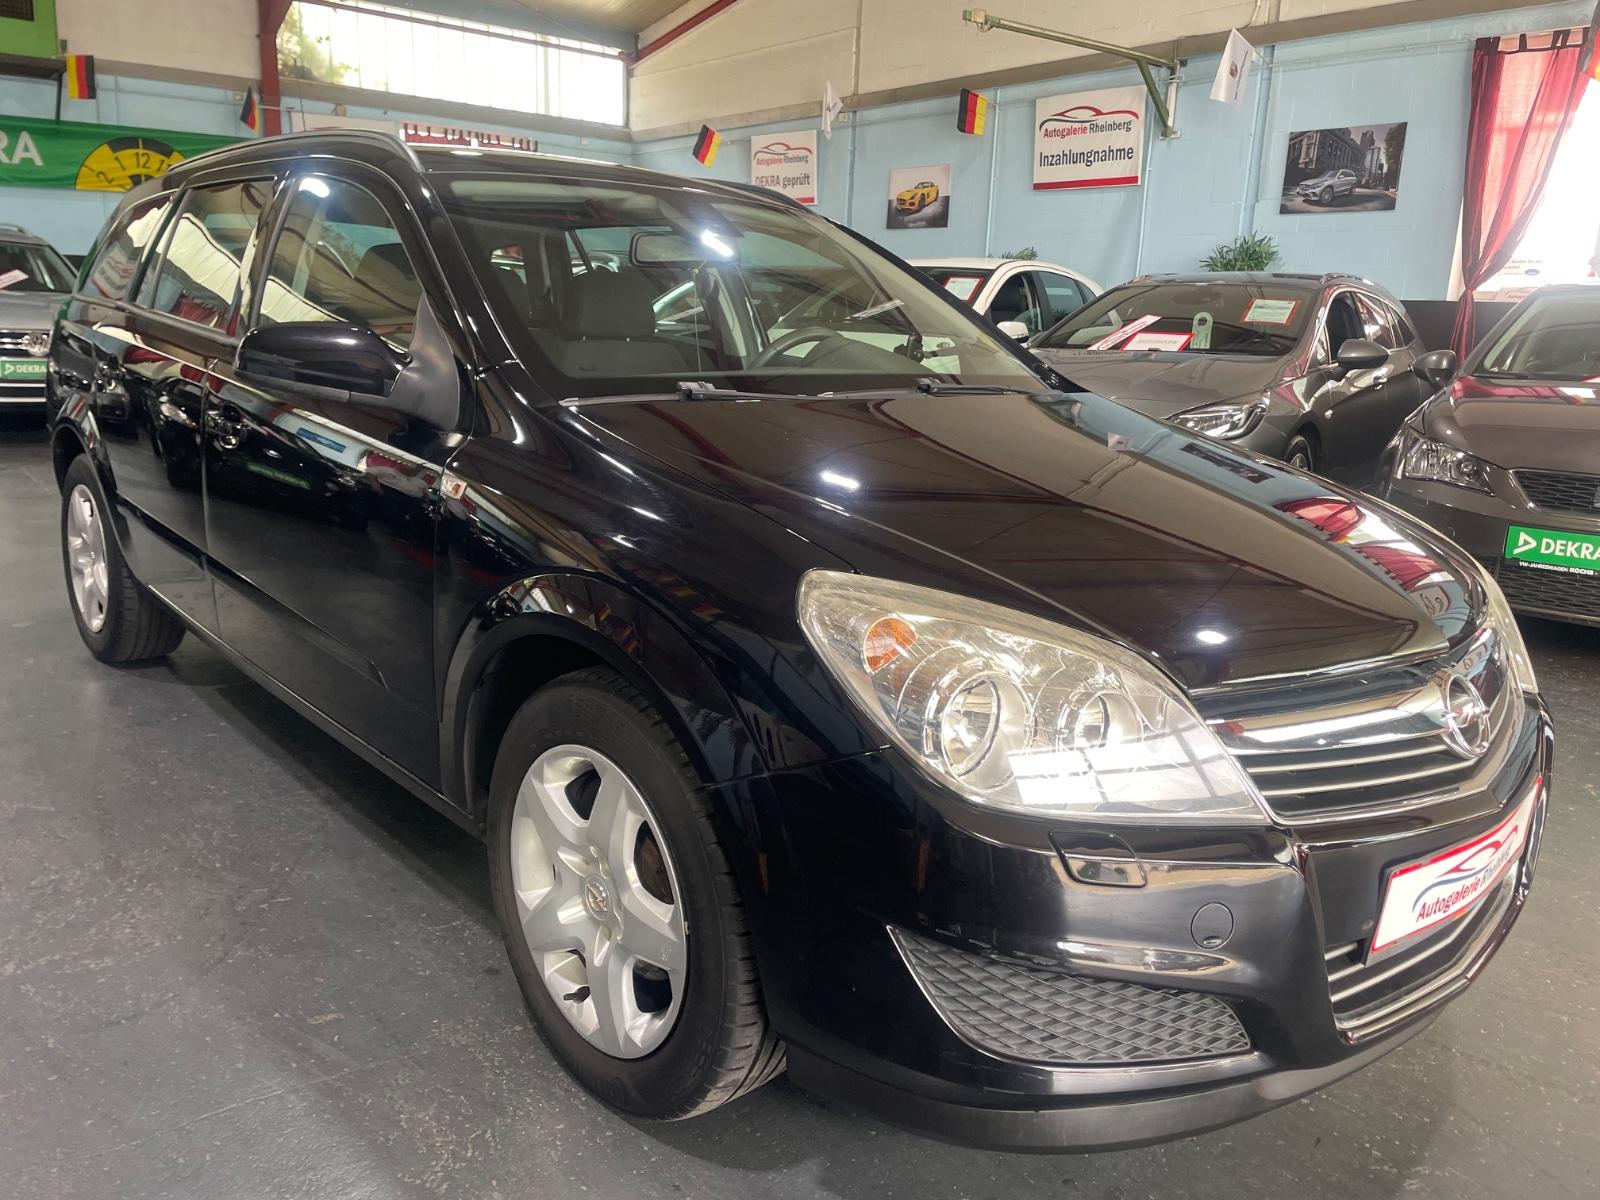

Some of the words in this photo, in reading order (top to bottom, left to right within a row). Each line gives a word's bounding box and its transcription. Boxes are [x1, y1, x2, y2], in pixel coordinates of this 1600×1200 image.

[1044, 124, 1088, 139] Autogalerie
[1089, 120, 1132, 133] Rheinberg
[134, 152, 150, 169] 12
[1040, 146, 1134, 168] Inzahlungnahme
[756, 175, 780, 186] DEKRA
[783, 173, 810, 188] geprüft
[1416, 876, 1481, 922] Autogalerie
